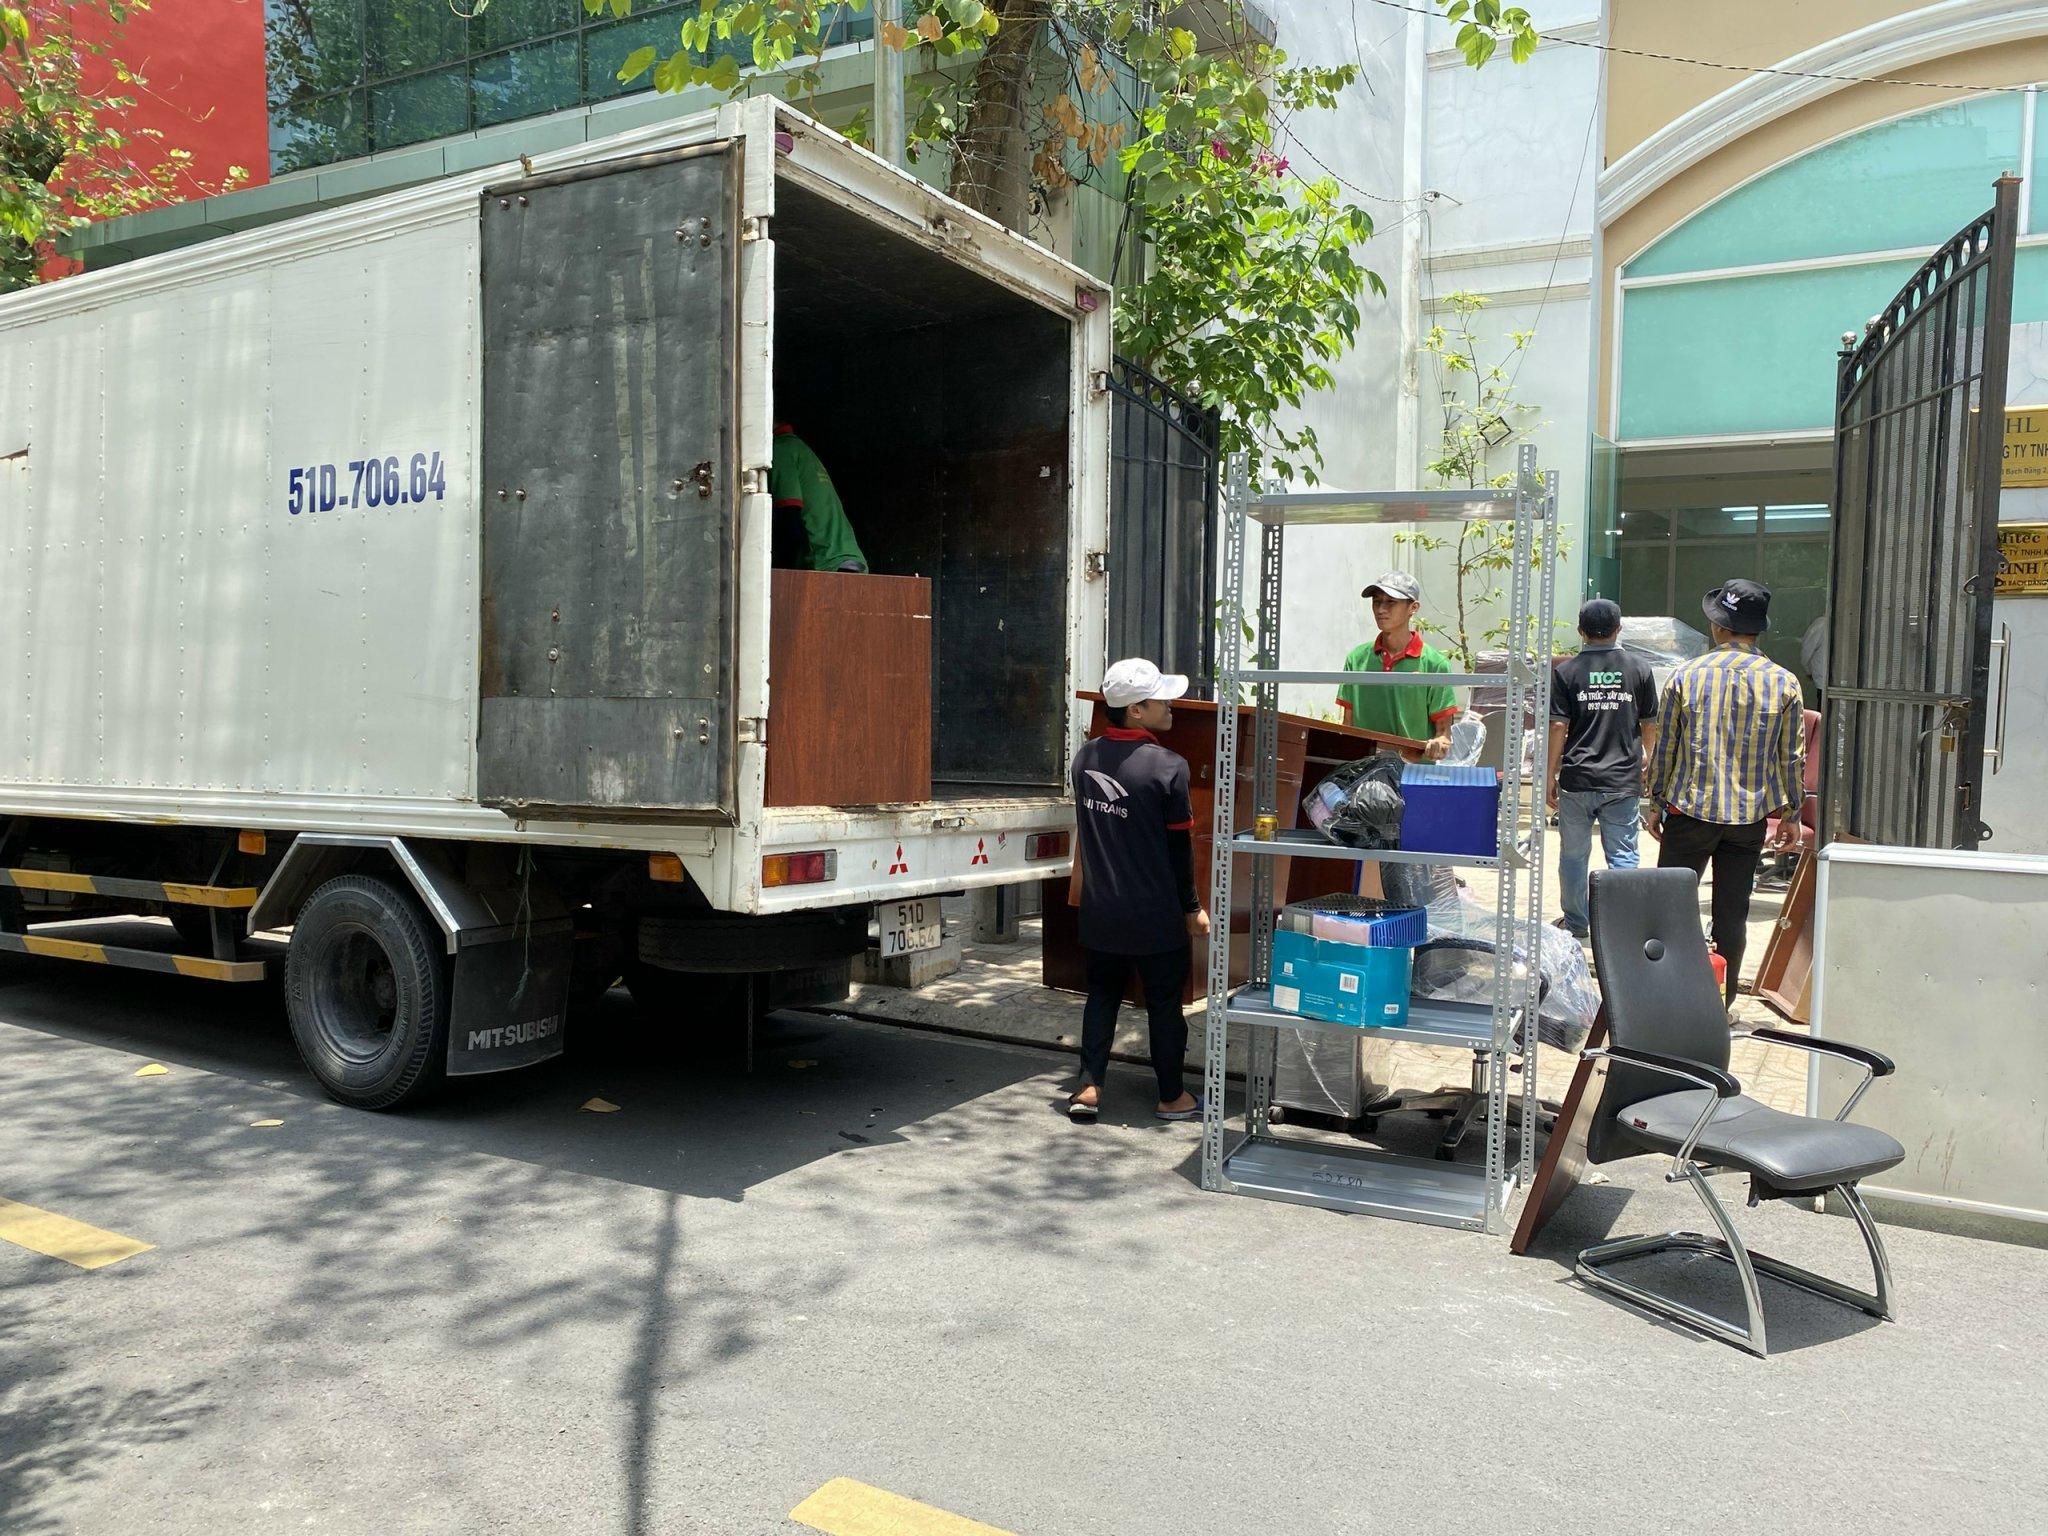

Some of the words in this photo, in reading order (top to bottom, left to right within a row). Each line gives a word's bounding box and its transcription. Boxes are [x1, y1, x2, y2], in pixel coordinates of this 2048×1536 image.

[2014, 444, 2027, 458] TY
[287, 451, 446, 515] 51D-706.64
[2000, 562, 2039, 575] INH
[898, 903, 924, 926] 51D
[888, 925, 936, 953] 706.64
[467, 1014, 560, 1051] MITSUBISHI
